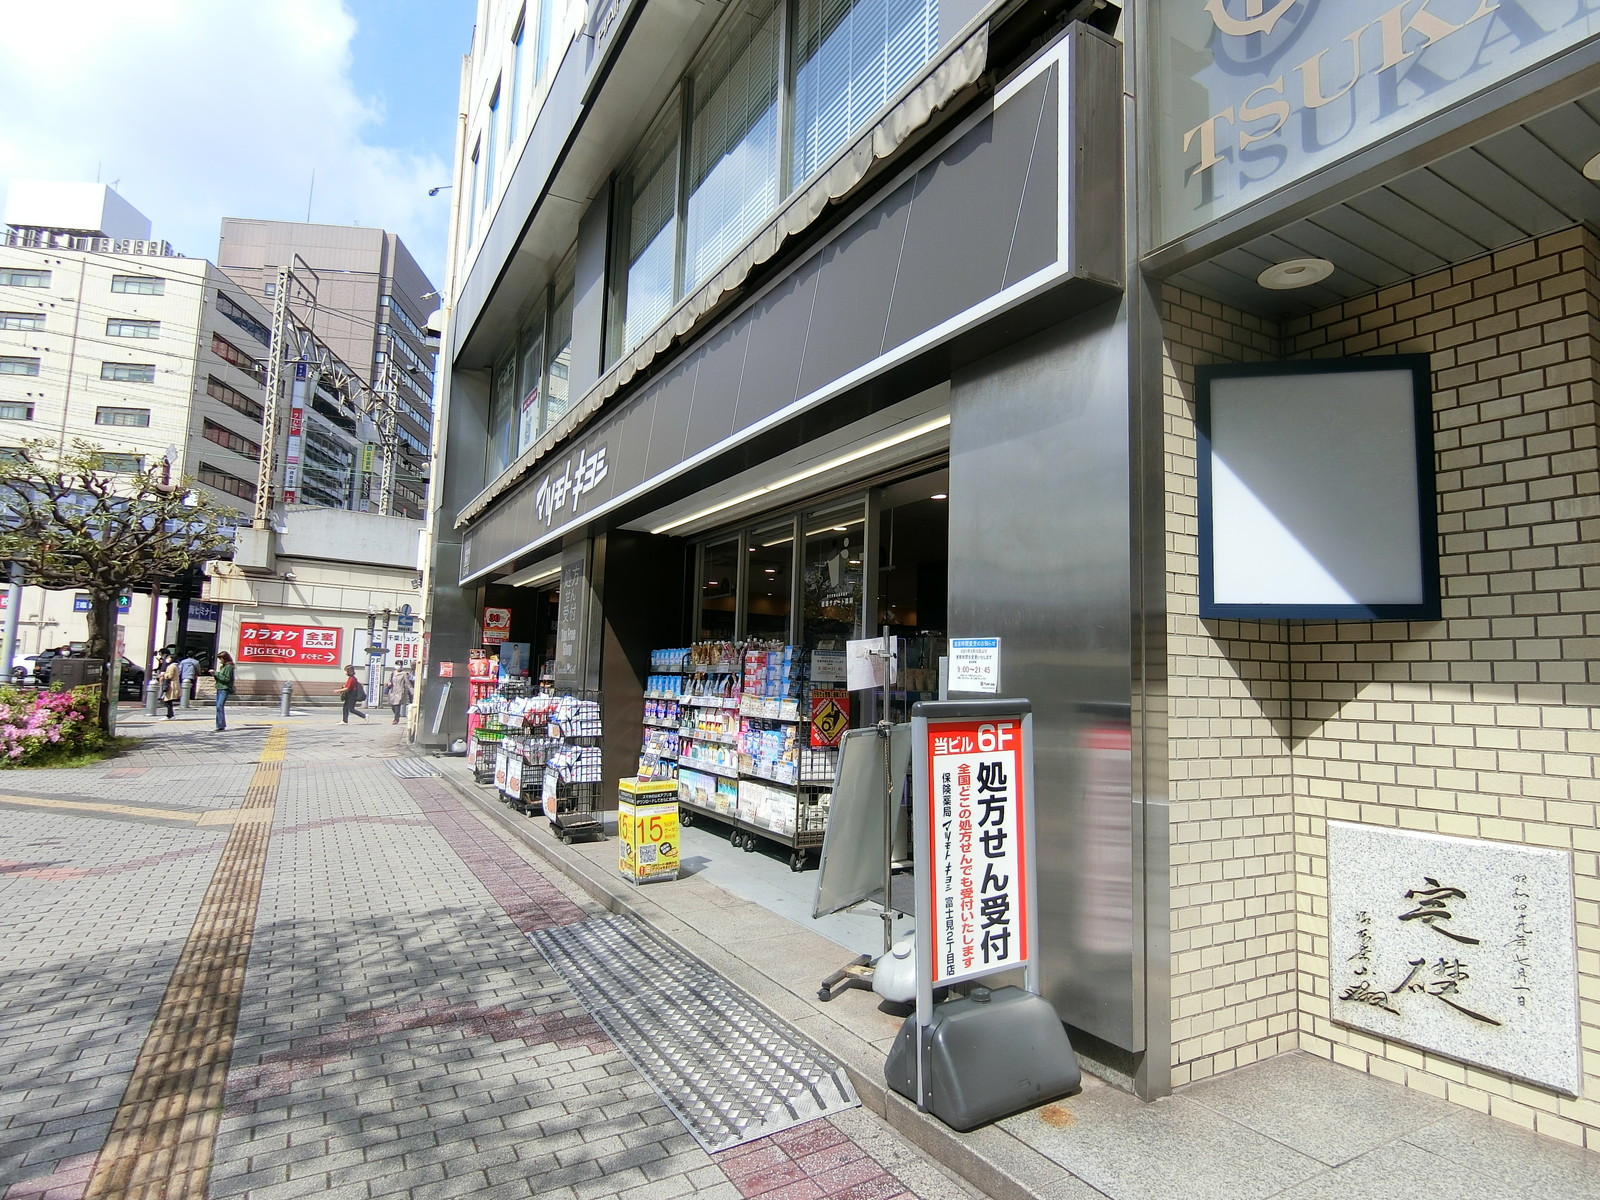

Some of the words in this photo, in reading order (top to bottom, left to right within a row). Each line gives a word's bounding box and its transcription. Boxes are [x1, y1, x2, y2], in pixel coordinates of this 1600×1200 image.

[1183, 0, 1500, 176] TSUK
[536, 447, 608, 527] マツモトキヨシ
[563, 566, 580, 589] 処方
[565, 588, 576, 603] せん
[562, 604, 576, 623] 受付
[243, 628, 300, 641] カラオケ
[243, 646, 265, 656] BIG
[266, 648, 296, 658] ECHO
[306, 632, 334, 641] 全室
[934, 736, 973, 755] 当ビル
[977, 723, 1014, 752] 6F
[942, 772, 952, 818] 保険薬局
[636, 816, 663, 844] 15
[942, 819, 953, 893] マツモトキヨシ
[957, 763, 975, 969] 全国どこの処方せんでも受付いたします
[977, 761, 1011, 964] 処方せん受付
[945, 896, 955, 977] 富士見2丁目店
[1391, 876, 1501, 1026] 定礎
